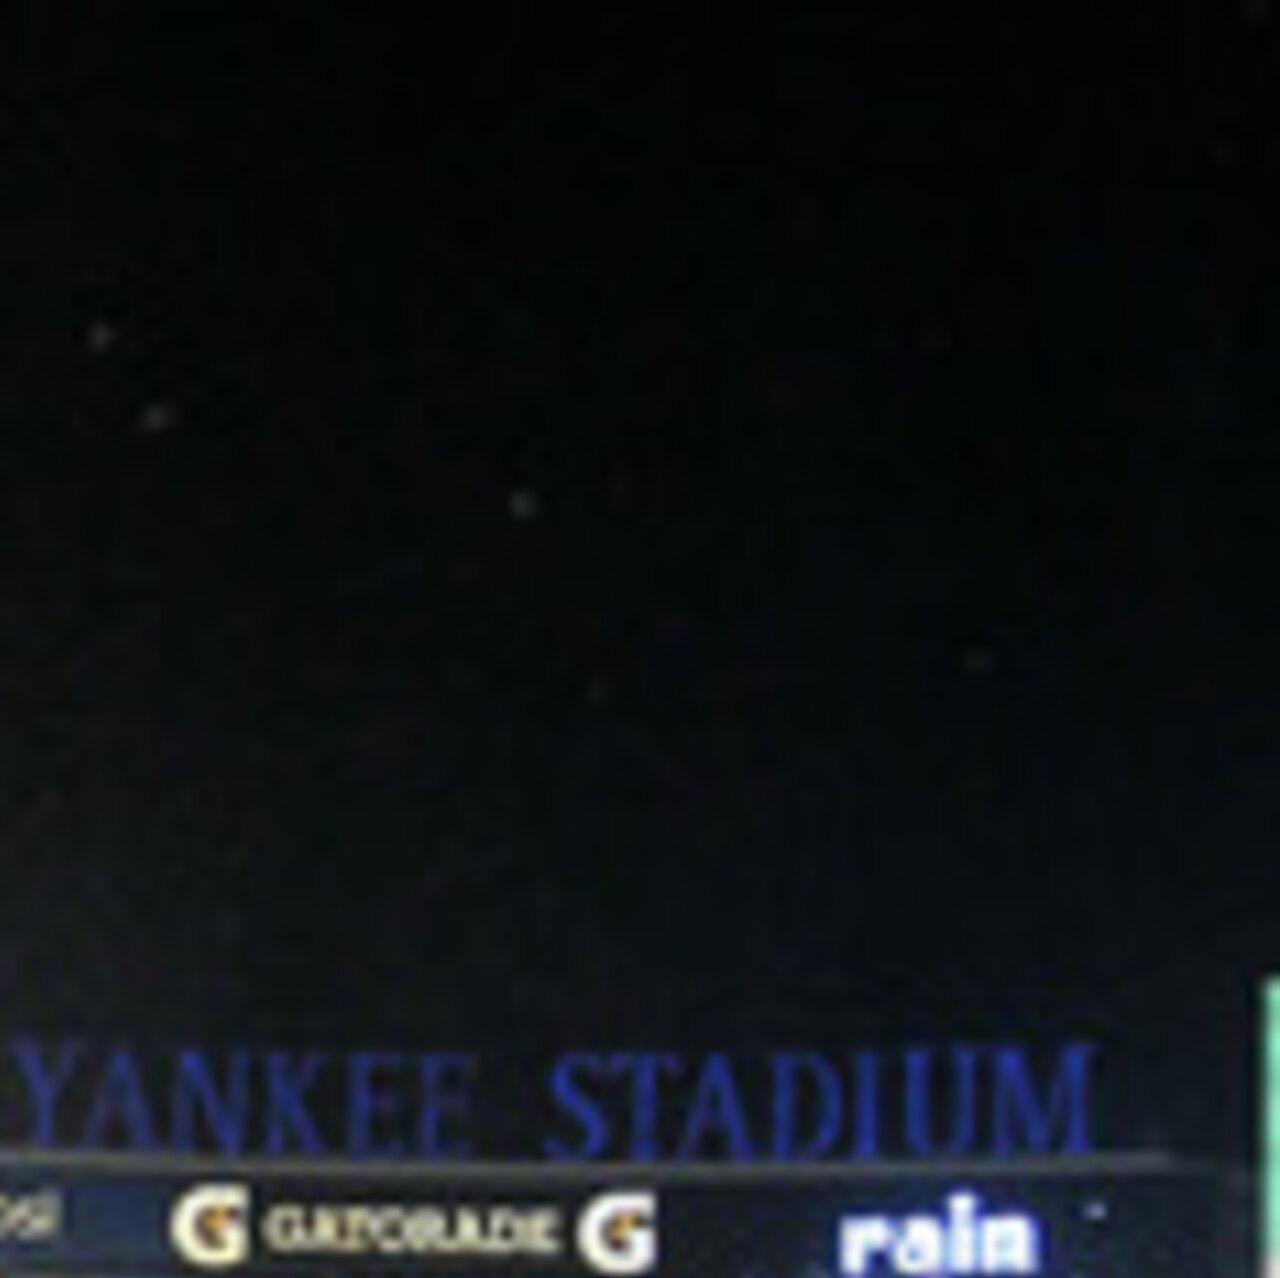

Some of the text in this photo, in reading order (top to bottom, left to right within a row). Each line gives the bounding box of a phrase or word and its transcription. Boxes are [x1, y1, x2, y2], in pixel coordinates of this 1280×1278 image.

[10, 1038, 1100, 1162] YANKEE STADIUM
[171, 1184, 657, 1275] G GATORADE G
[838, 1194, 1040, 1275] rain
